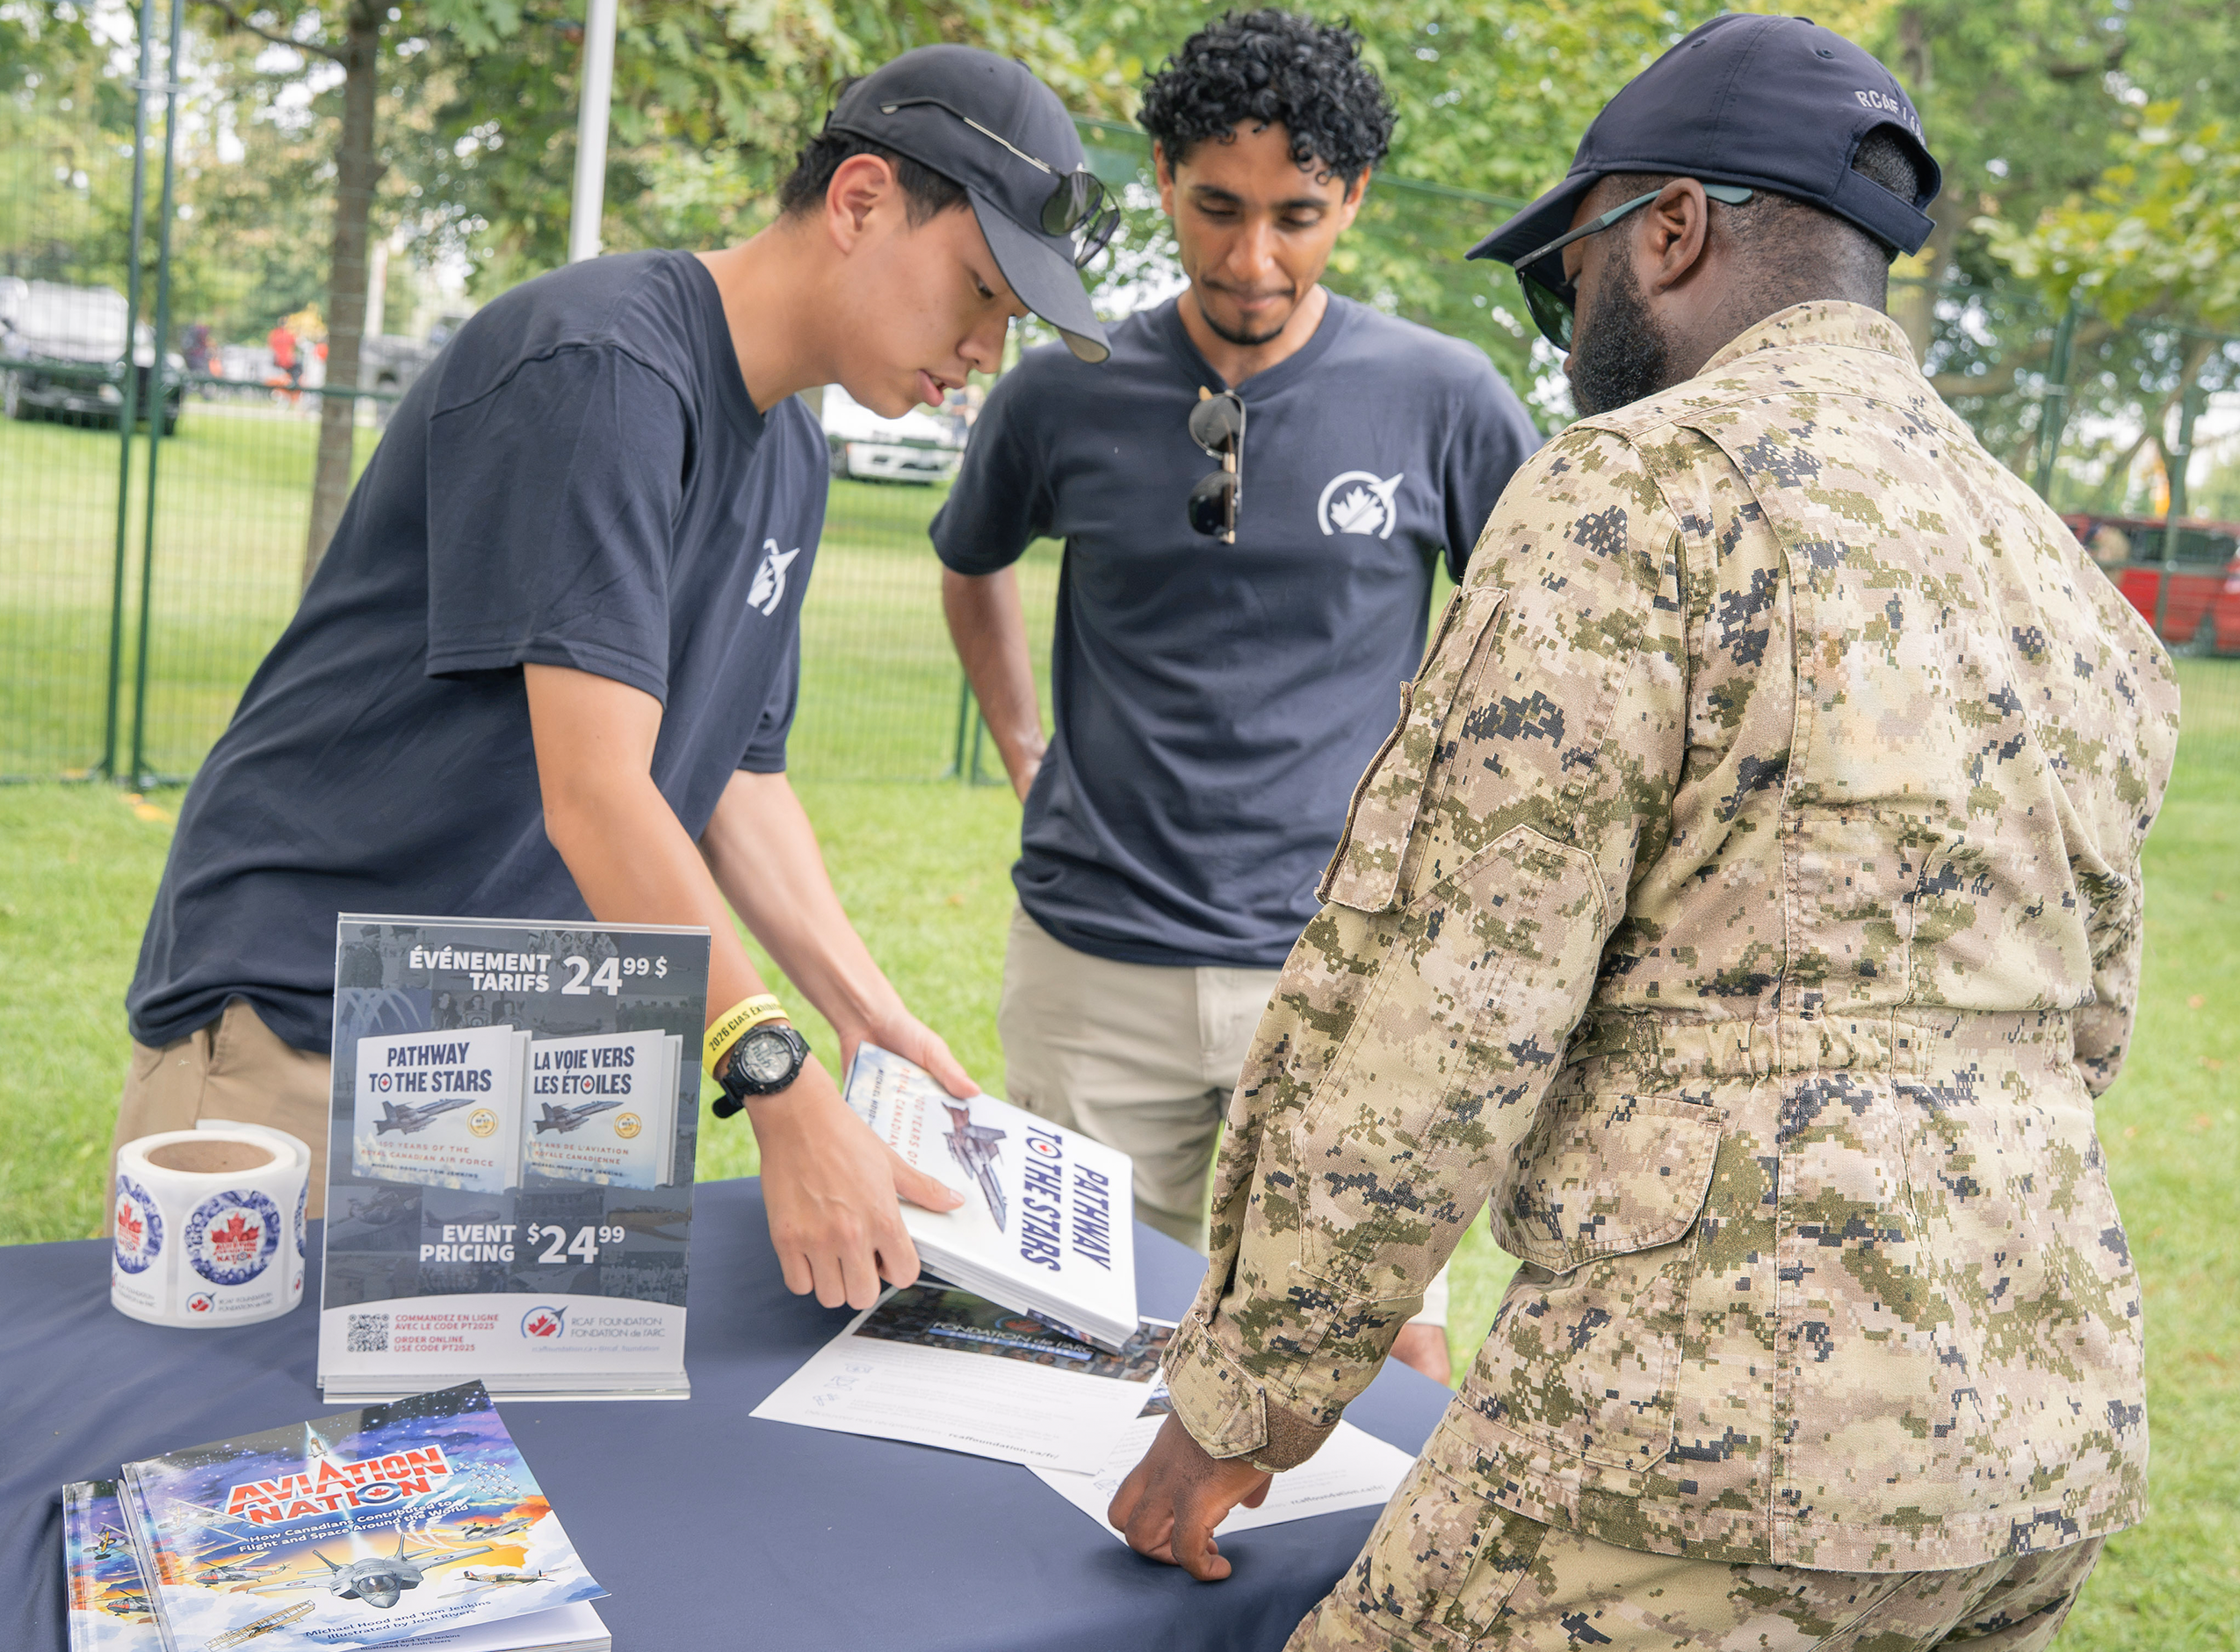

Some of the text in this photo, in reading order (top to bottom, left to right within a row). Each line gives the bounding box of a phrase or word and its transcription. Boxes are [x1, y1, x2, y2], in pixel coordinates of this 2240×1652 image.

[1854, 90, 1898, 113] RCAF
[409, 945, 551, 971] ÉVÉNEMENT
[469, 972, 549, 992] TARIFS
[727, 1011, 751, 1031] CIAS
[387, 1042, 470, 1067] PATHWAY
[534, 1046, 635, 1070] LA VOIE VERS
[369, 1069, 492, 1093] TO THE STARS
[534, 1070, 632, 1094] LES ÉTOILES
[888, 1099, 906, 1148] CANADIAN
[908, 1115, 923, 1148] YEARS
[389, 1151, 435, 1161] CANADIAN
[459, 1158, 494, 1167] FORCE
[566, 1154, 620, 1165] CANADIENNE
[578, 1145, 629, 1155] L'AVIATION
[907, 1151, 918, 1165] OF
[1021, 1126, 1063, 1272] TO THE STARS
[1073, 1163, 1111, 1271] PATHWAY
[442, 1224, 517, 1243] EVENT
[419, 1244, 515, 1263] PRICING
[571, 1317, 662, 1326] RCAF FOUNDATION
[933, 1321, 1031, 1343] FONDATION
[228, 1447, 448, 1514] AVIATION
[249, 1477, 431, 1525] NATION
[239, 1504, 469, 1553] Flight and Space Around the World
[249, 1532, 281, 1543] How
[285, 1519, 354, 1536] Canadians
[357, 1504, 435, 1523] Contributed
[306, 1624, 354, 1637] Michael
[358, 1618, 391, 1628] Hood
[419, 1609, 445, 1618] Tom
[447, 1600, 491, 1613] Jenkins
[327, 1624, 390, 1640] Illustrated
[411, 1614, 439, 1625] Josh
[441, 1608, 477, 1620] Rivers
